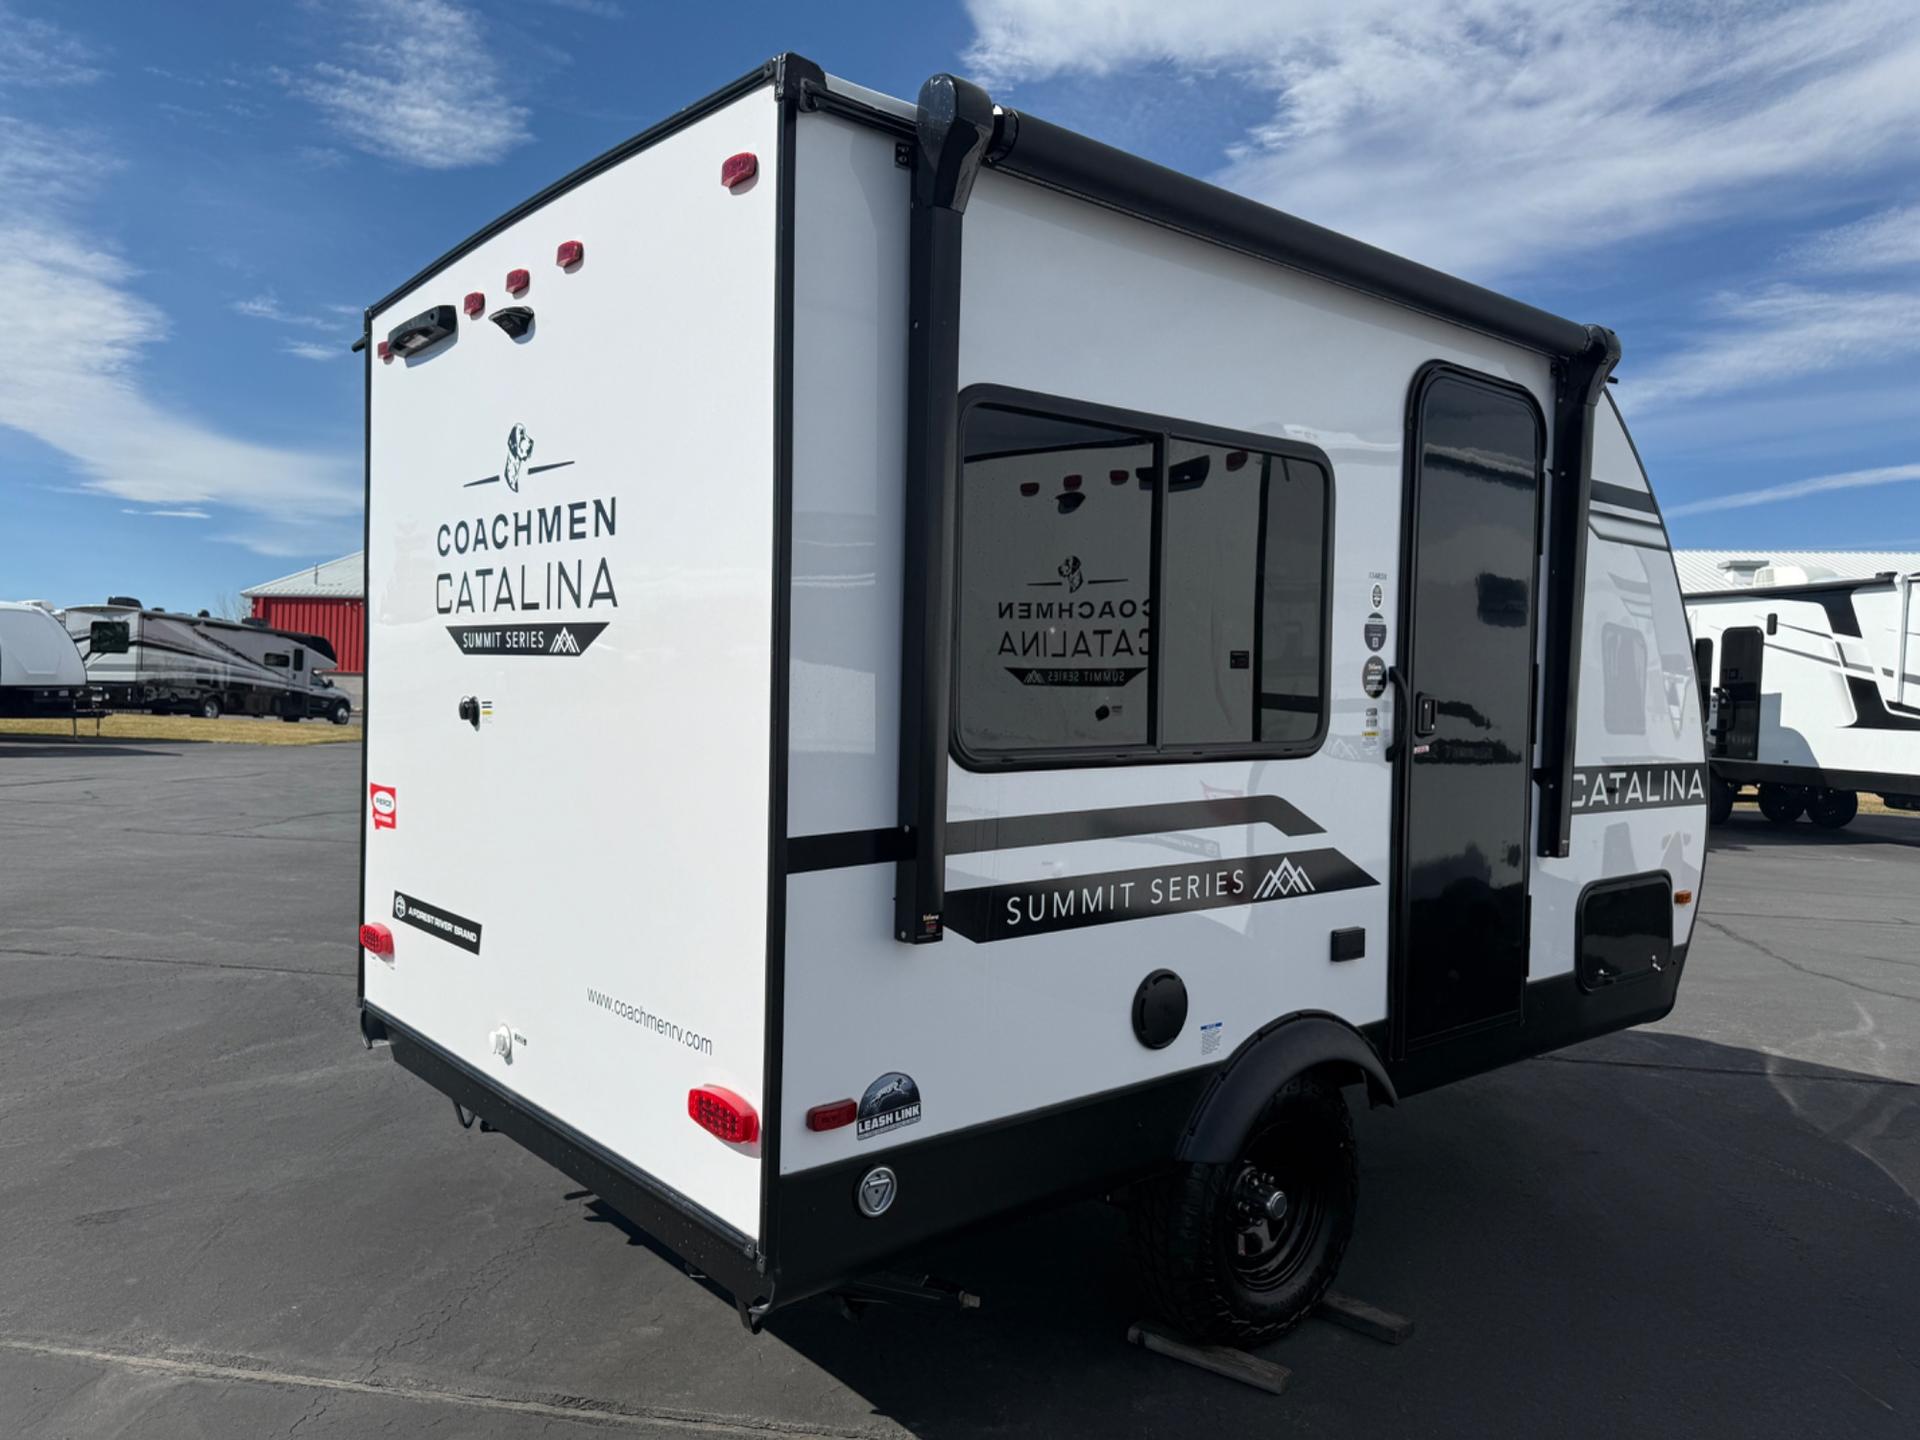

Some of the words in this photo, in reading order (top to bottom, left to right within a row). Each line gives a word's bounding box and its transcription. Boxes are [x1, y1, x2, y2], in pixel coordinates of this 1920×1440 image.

[437, 497, 616, 557] COACHMEN
[436, 557, 618, 614] CATALINA
[463, 631, 502, 648] SUMMIT
[505, 631, 545, 648] SERIES
[1572, 769, 1704, 807] CATALINA
[1006, 882, 1135, 925] SUMMIT
[1150, 869, 1245, 904] SERIES
[413, 908, 434, 924] FOREST
[434, 917, 453, 933] RIVER
[454, 925, 477, 943] BRAND
[587, 987, 712, 1055] www.coachmenrv.com
[858, 1112, 893, 1133] LEASH
[895, 1104, 920, 1121] LINK
